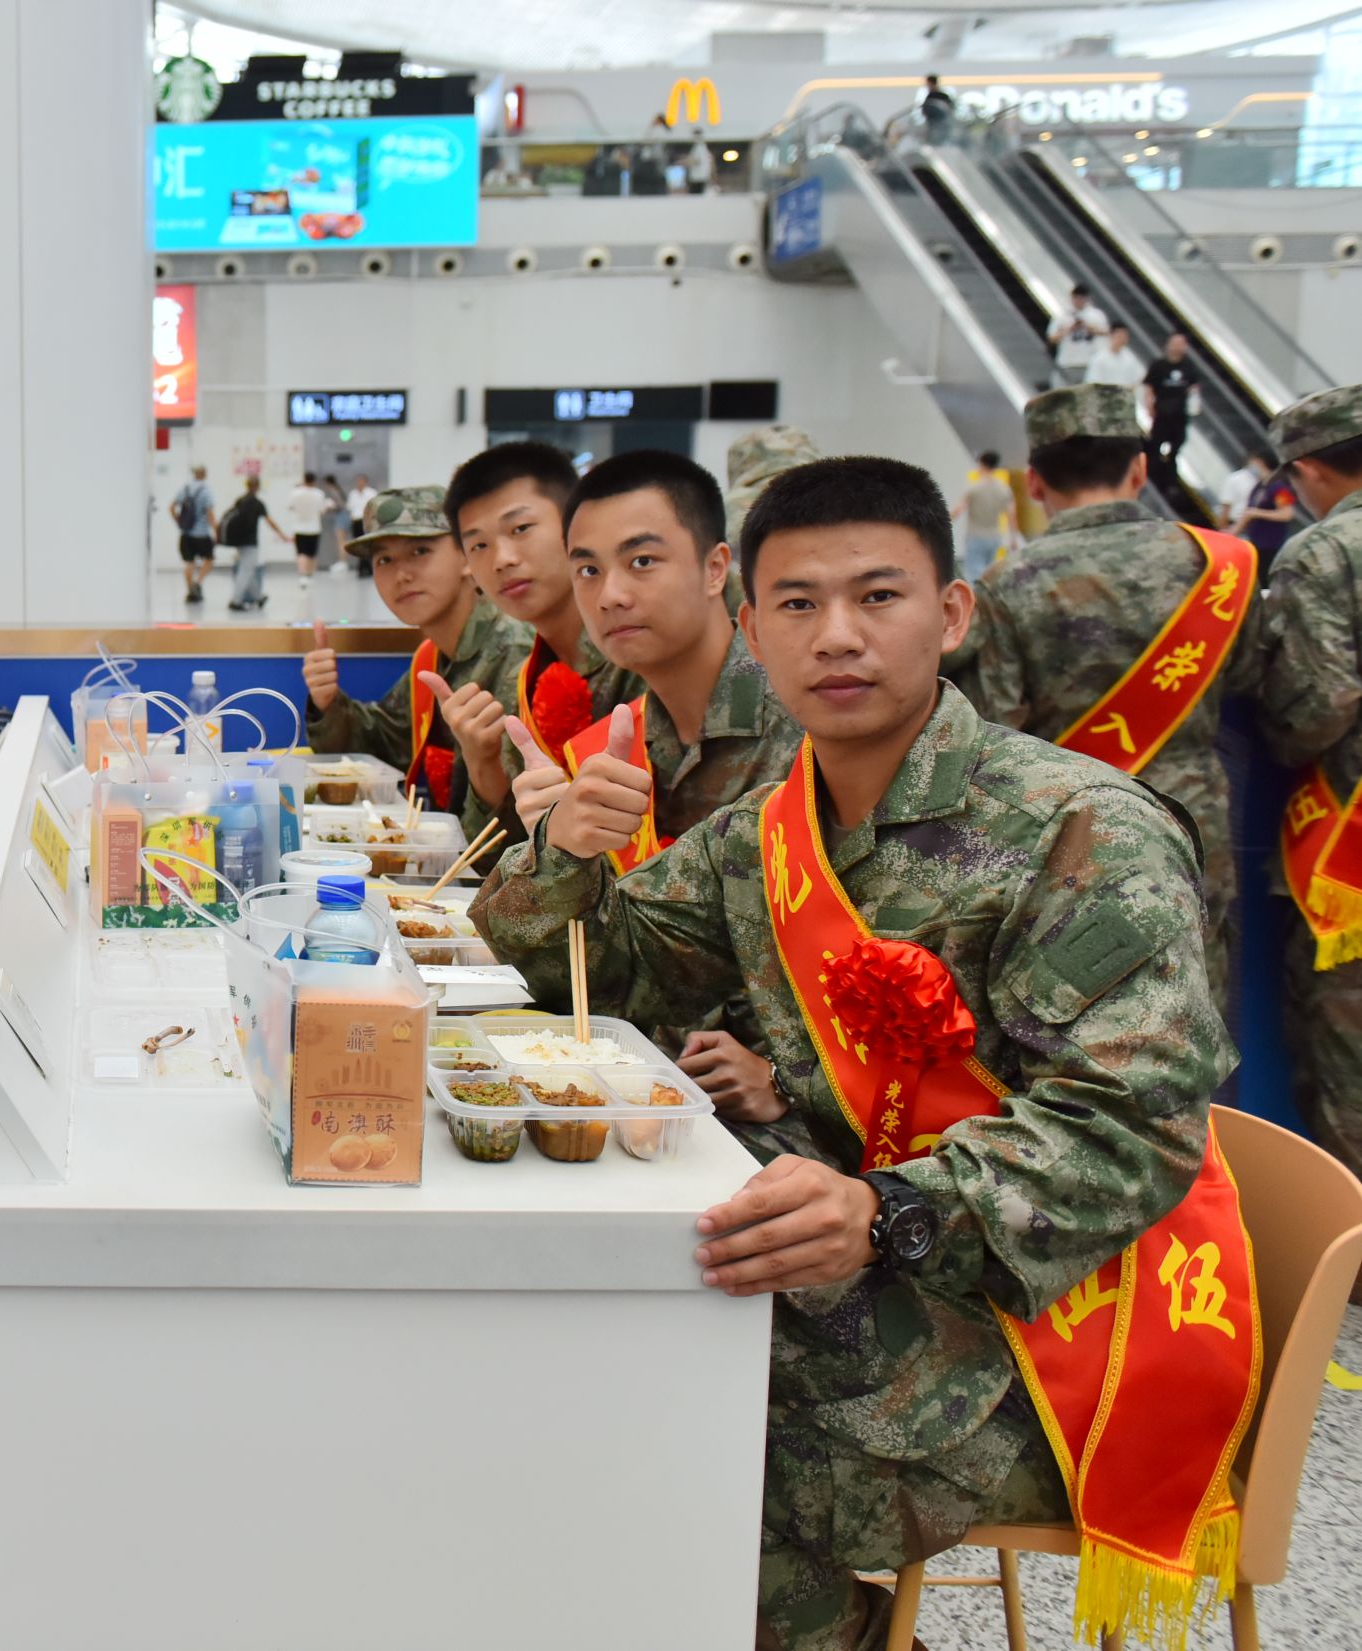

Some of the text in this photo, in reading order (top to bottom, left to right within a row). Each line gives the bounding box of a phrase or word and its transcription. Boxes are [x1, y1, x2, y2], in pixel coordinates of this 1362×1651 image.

[257, 79, 396, 102] STARBUCKS
[283, 98, 380, 119] COFFEE
[154, 145, 206, 198] 汇
[1090, 562, 1240, 753] 光荣入
[1157, 1233, 1236, 1339] 伍
